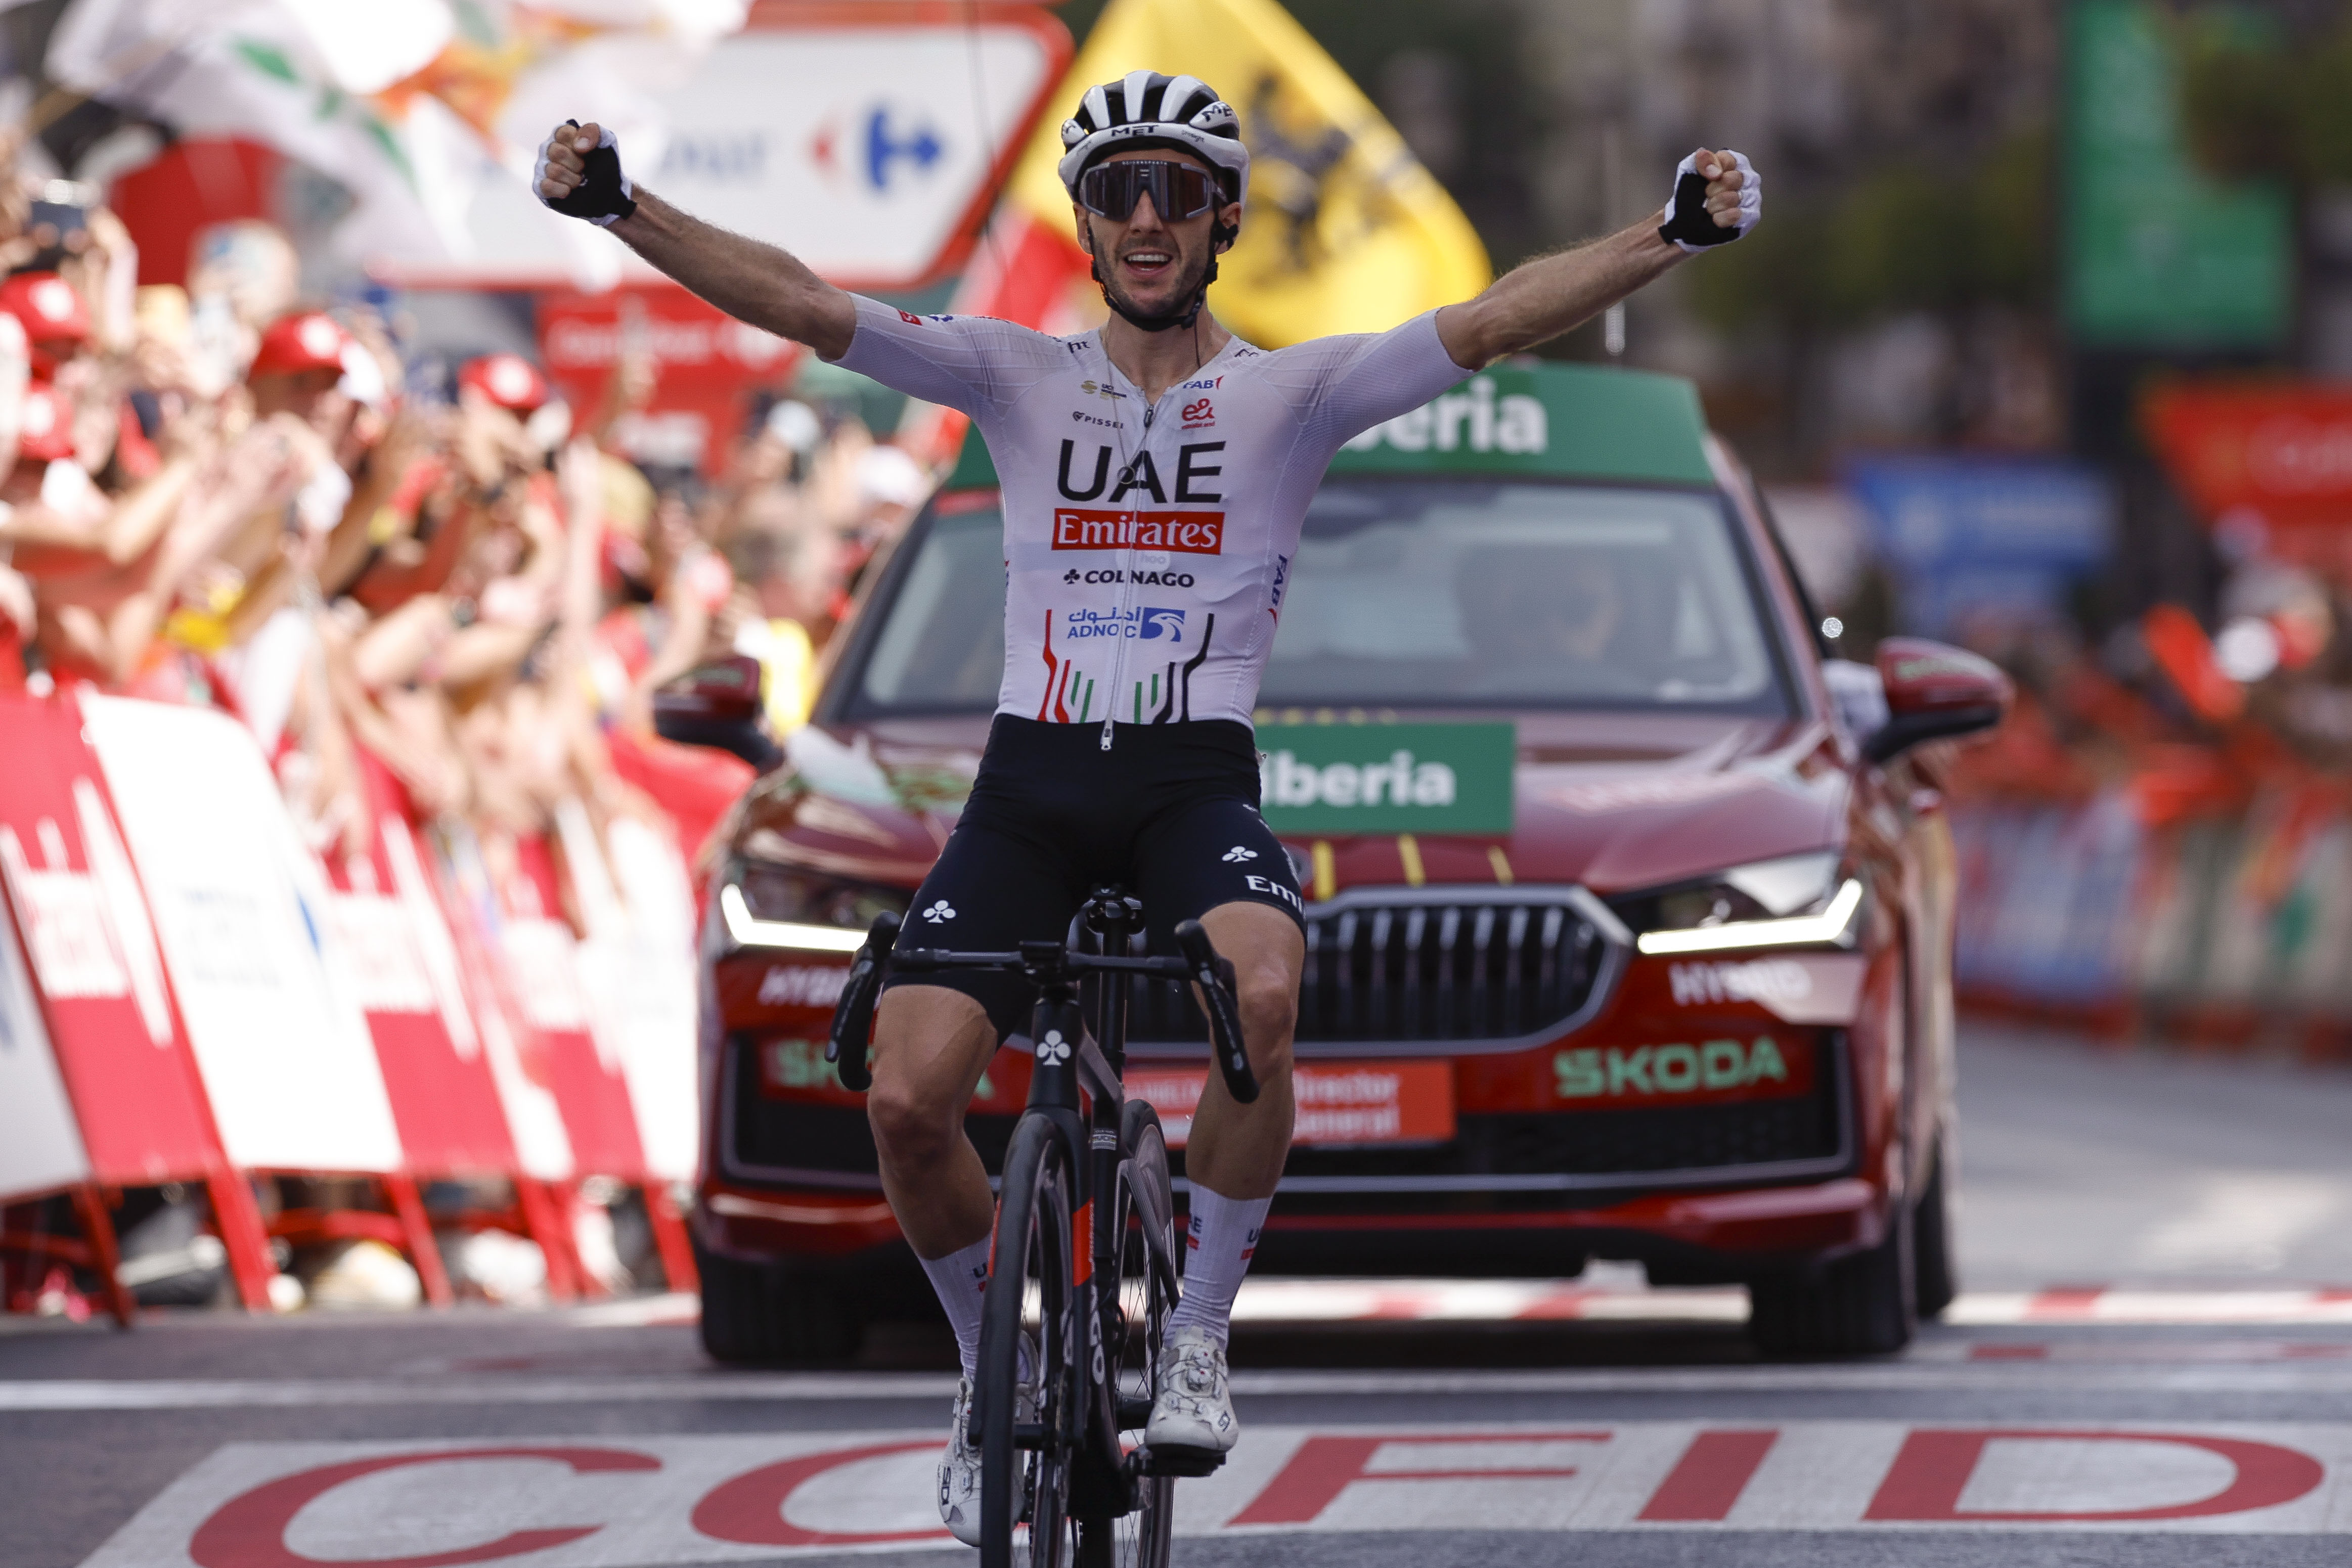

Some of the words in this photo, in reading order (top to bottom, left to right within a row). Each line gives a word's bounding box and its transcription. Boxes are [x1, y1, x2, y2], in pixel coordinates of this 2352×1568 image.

[1112, 124, 1159, 137] MET
[1057, 438, 1226, 504] UAE
[1057, 513, 1217, 548] Emirates
[1084, 569, 1194, 588] COLNAGO
[1067, 624, 1137, 639] ADNOC
[1245, 875, 1306, 922] Emi
